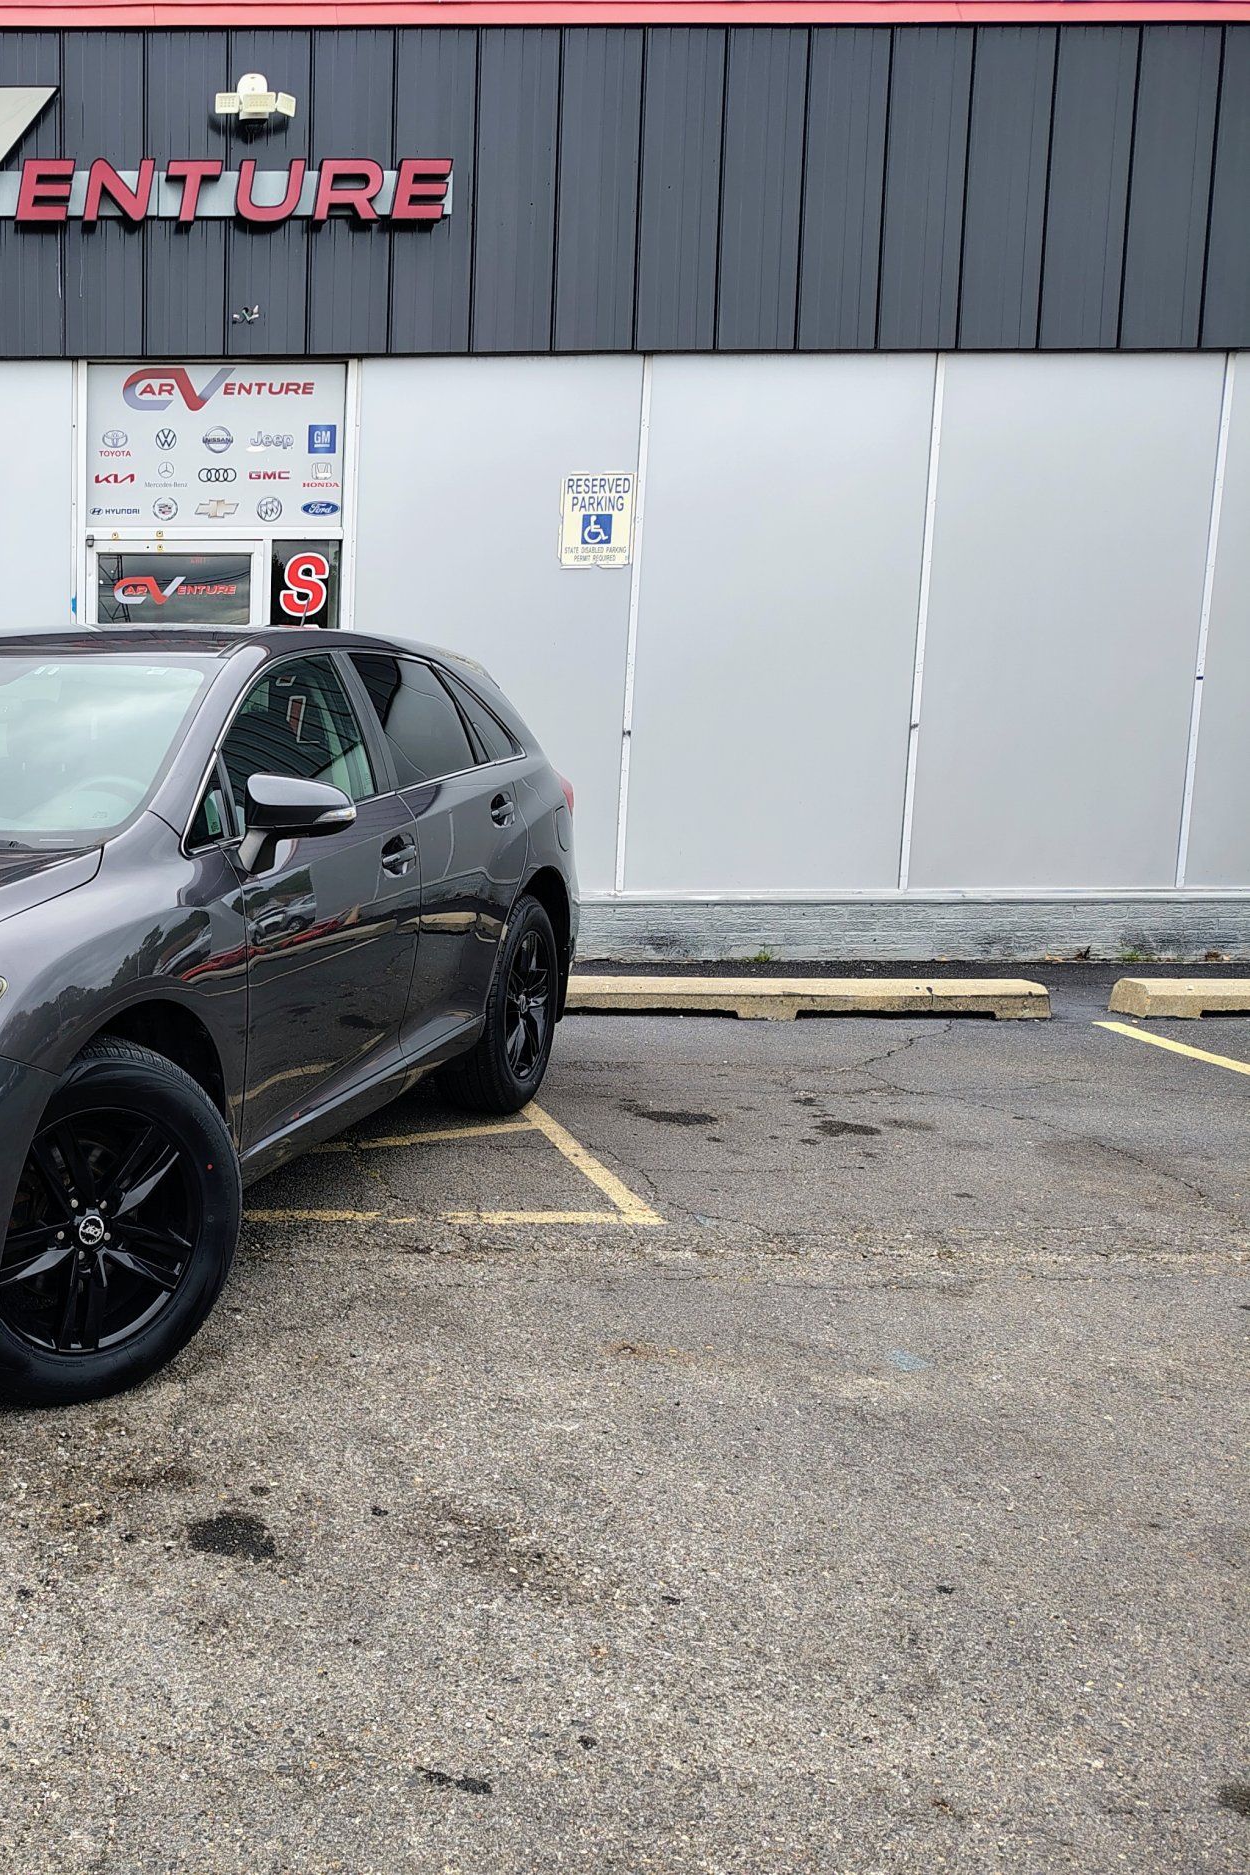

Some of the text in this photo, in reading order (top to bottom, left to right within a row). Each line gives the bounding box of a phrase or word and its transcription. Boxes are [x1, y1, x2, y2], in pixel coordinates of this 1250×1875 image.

[203, 436, 232, 444] NISSAN
[250, 431, 294, 449] Jeep
[314, 431, 330, 444] GM
[249, 471, 291, 480] GMC
[567, 477, 631, 494] RESERVED
[308, 502, 332, 514] Ford
[571, 495, 624, 512] PARKING
[564, 546, 579, 554] STATE
